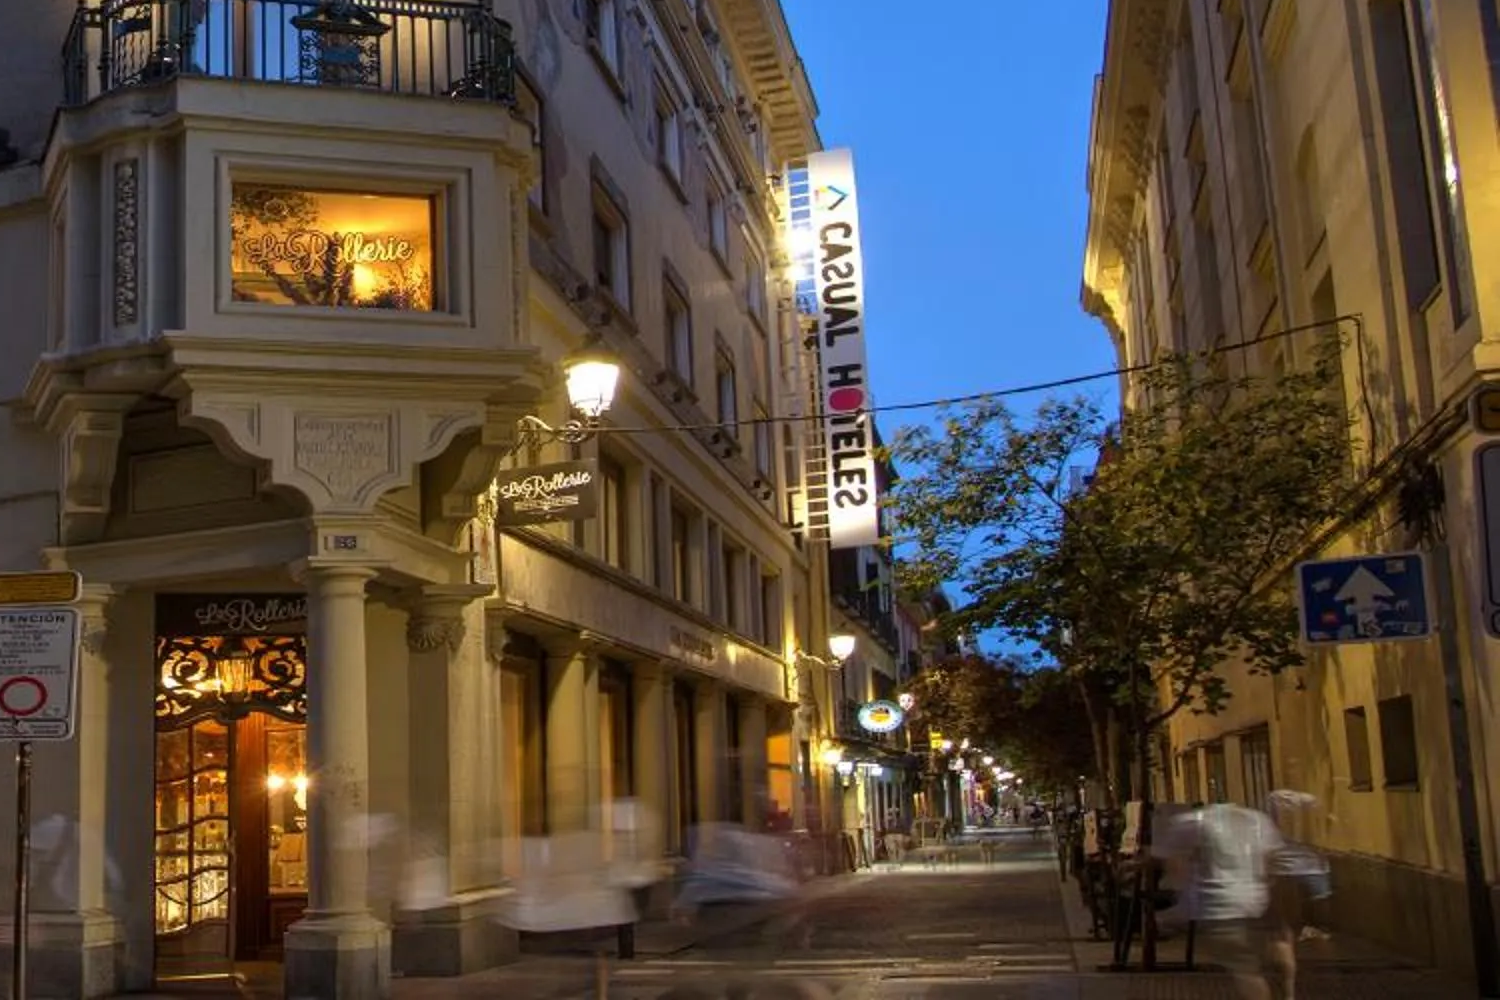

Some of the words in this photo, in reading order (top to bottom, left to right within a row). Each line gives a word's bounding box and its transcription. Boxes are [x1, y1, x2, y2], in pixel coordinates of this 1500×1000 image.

[244, 233, 289, 265] La
[287, 229, 413, 274] Rollerie
[819, 221, 860, 348] CASUAL
[827, 363, 869, 509] HOTELES
[519, 471, 592, 499] Rollerie
